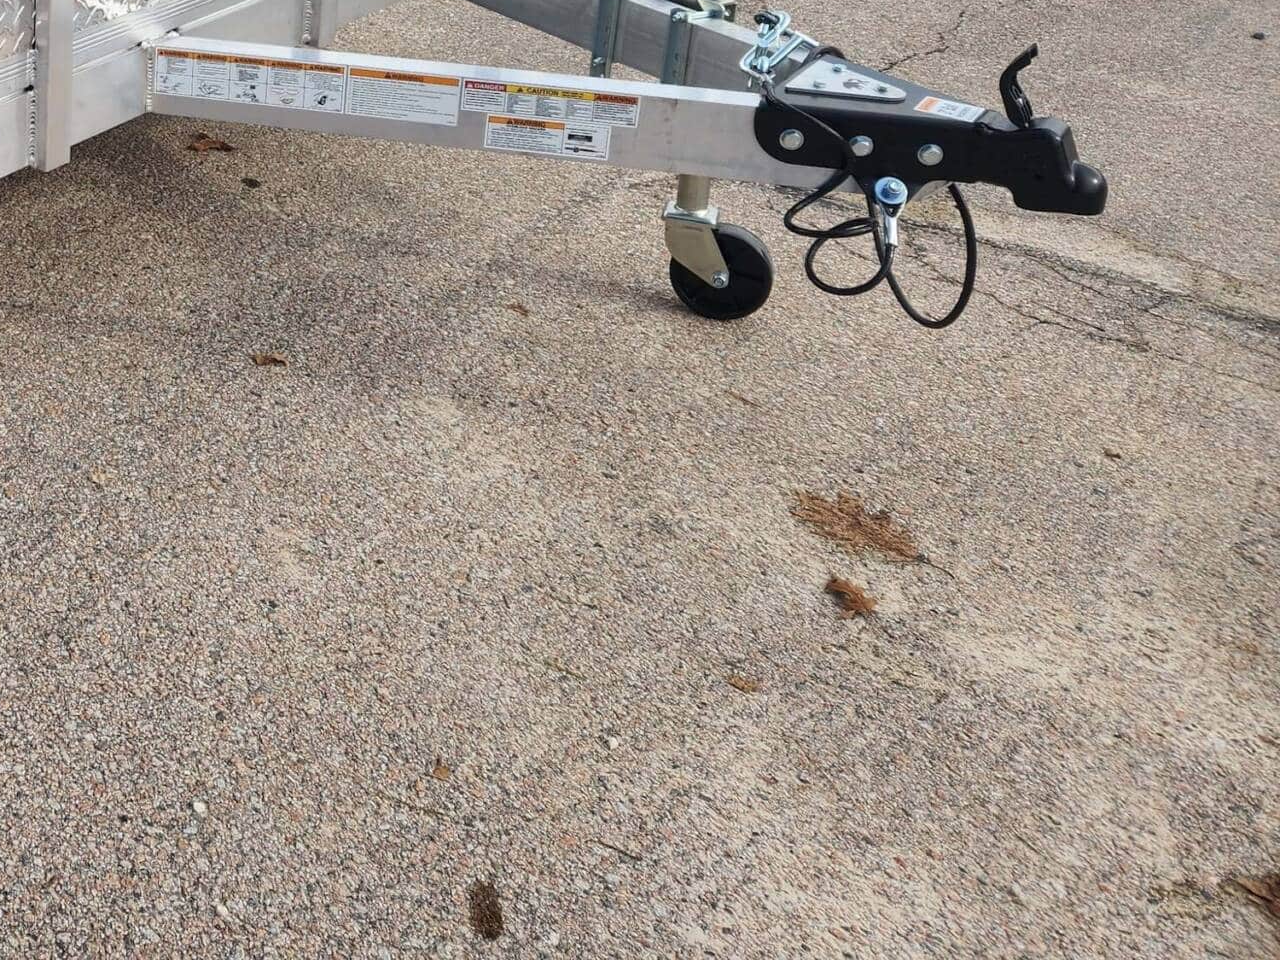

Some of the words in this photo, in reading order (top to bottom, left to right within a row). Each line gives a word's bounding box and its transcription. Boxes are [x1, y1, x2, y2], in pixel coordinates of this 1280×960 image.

[474, 83, 505, 91] DANGER
[526, 87, 559, 97] CAUTION
[514, 118, 546, 128] WARNING
